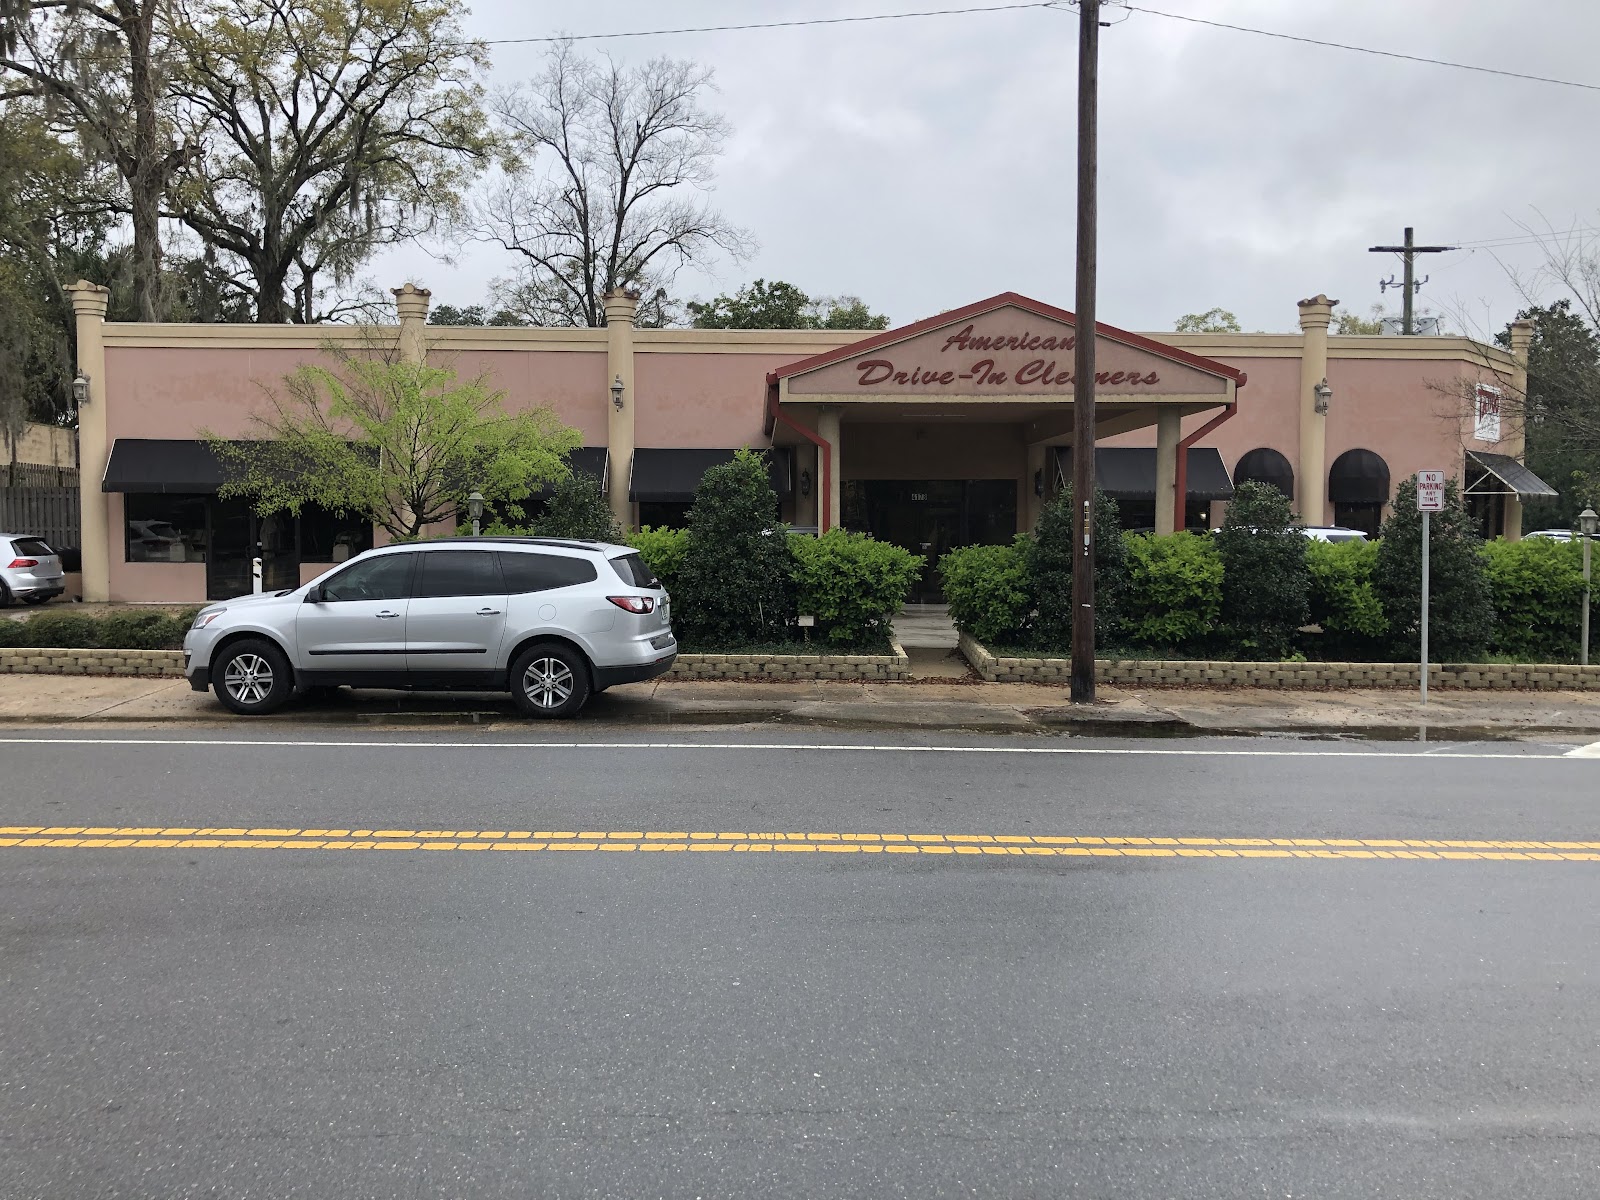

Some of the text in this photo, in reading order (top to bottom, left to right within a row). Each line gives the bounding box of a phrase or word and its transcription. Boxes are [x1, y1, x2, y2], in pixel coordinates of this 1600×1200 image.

[941, 324, 1076, 352] American
[856, 359, 1160, 386] Drive-In Cleners
[1419, 482, 1443, 490] PARKING
[1425, 473, 1437, 482] NO
